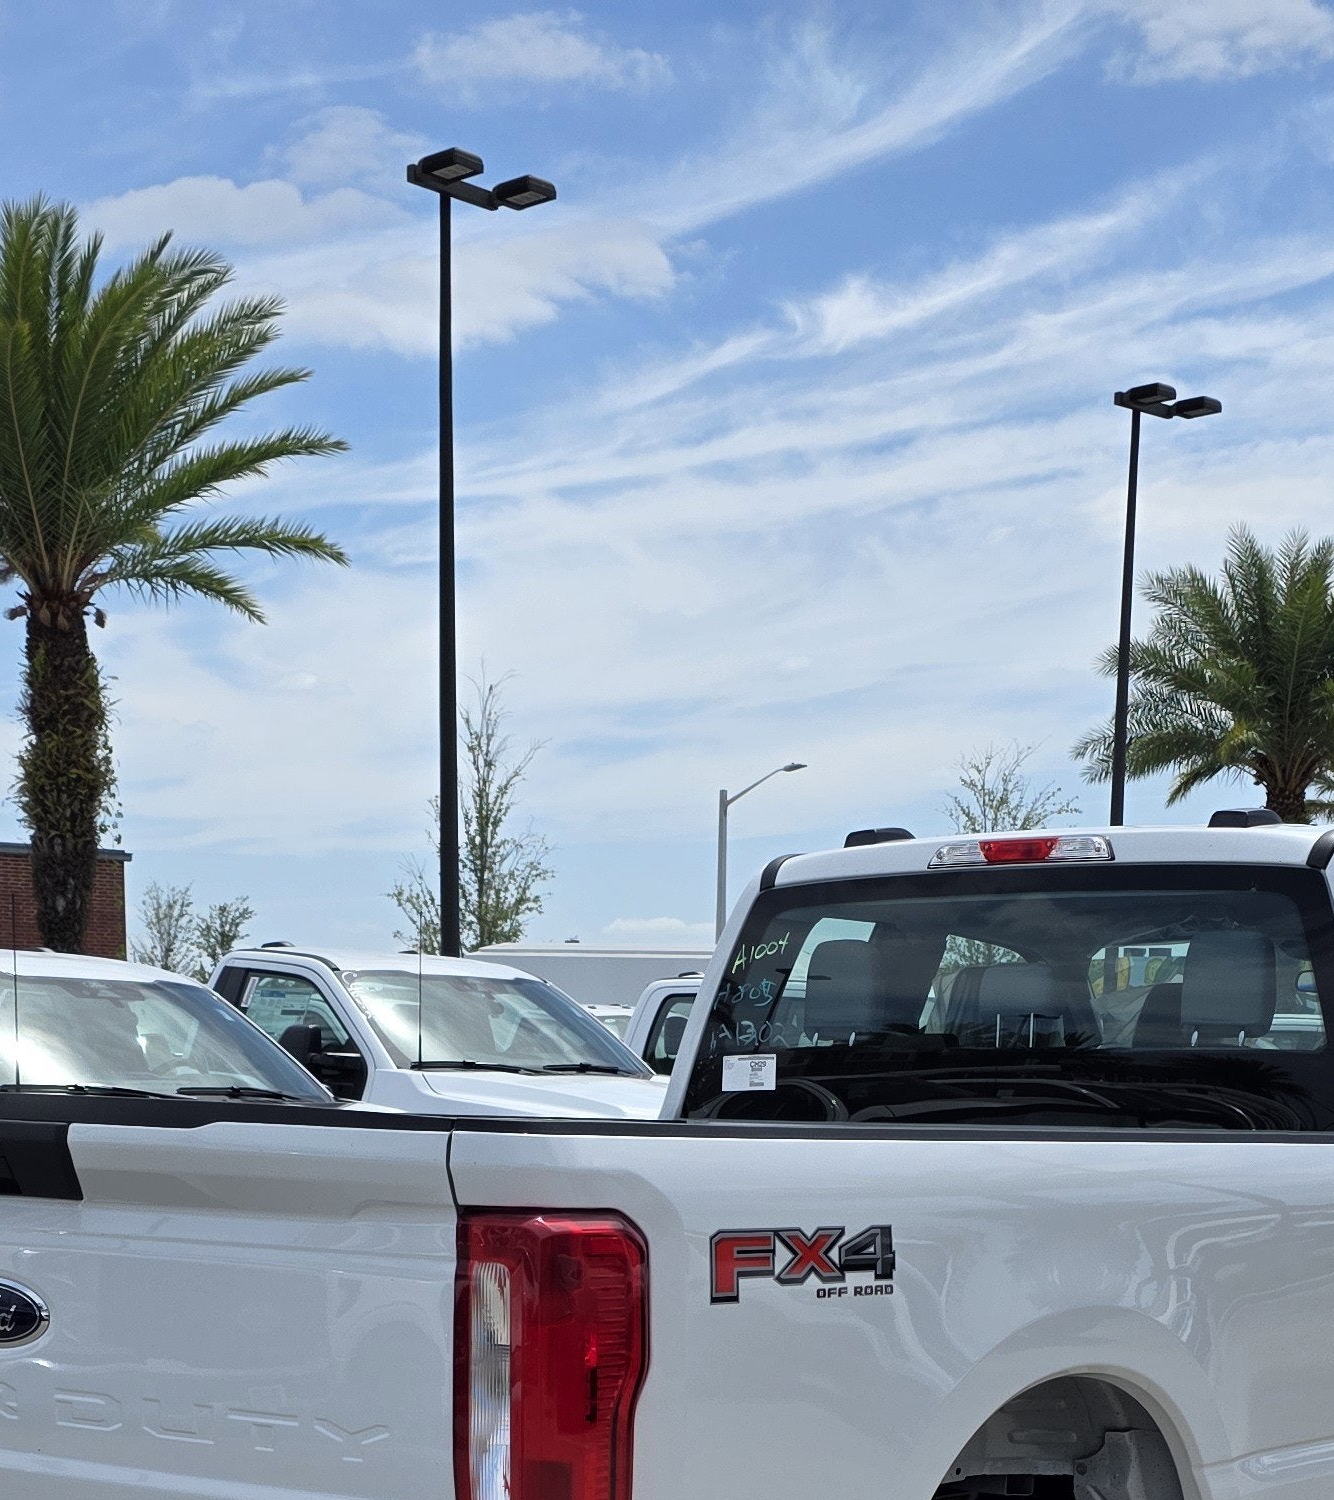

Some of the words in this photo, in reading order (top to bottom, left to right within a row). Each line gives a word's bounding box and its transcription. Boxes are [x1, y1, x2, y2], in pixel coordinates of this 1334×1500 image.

[710, 1224, 896, 1306] FX4
[816, 1286, 848, 1299] OFF
[853, 1284, 894, 1298] ROAD
[53, 1386, 390, 1463] DUTY
